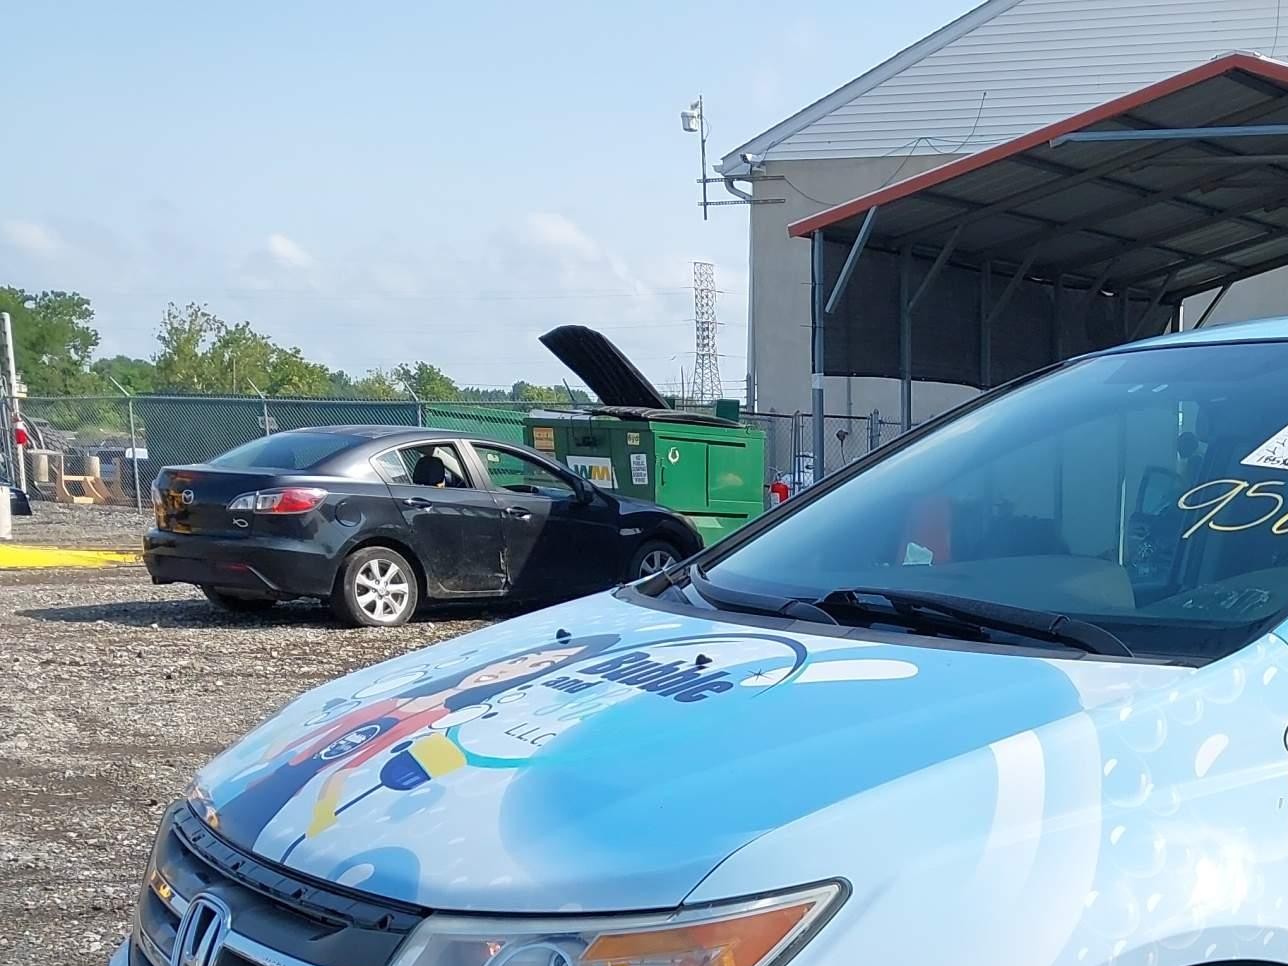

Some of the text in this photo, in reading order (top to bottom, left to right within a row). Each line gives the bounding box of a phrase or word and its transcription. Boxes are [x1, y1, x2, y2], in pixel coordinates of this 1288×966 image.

[574, 464, 611, 480] WM
[541, 676, 604, 694] and
[576, 651, 734, 703] Bubble
[503, 722, 557, 747] L.L.C.
